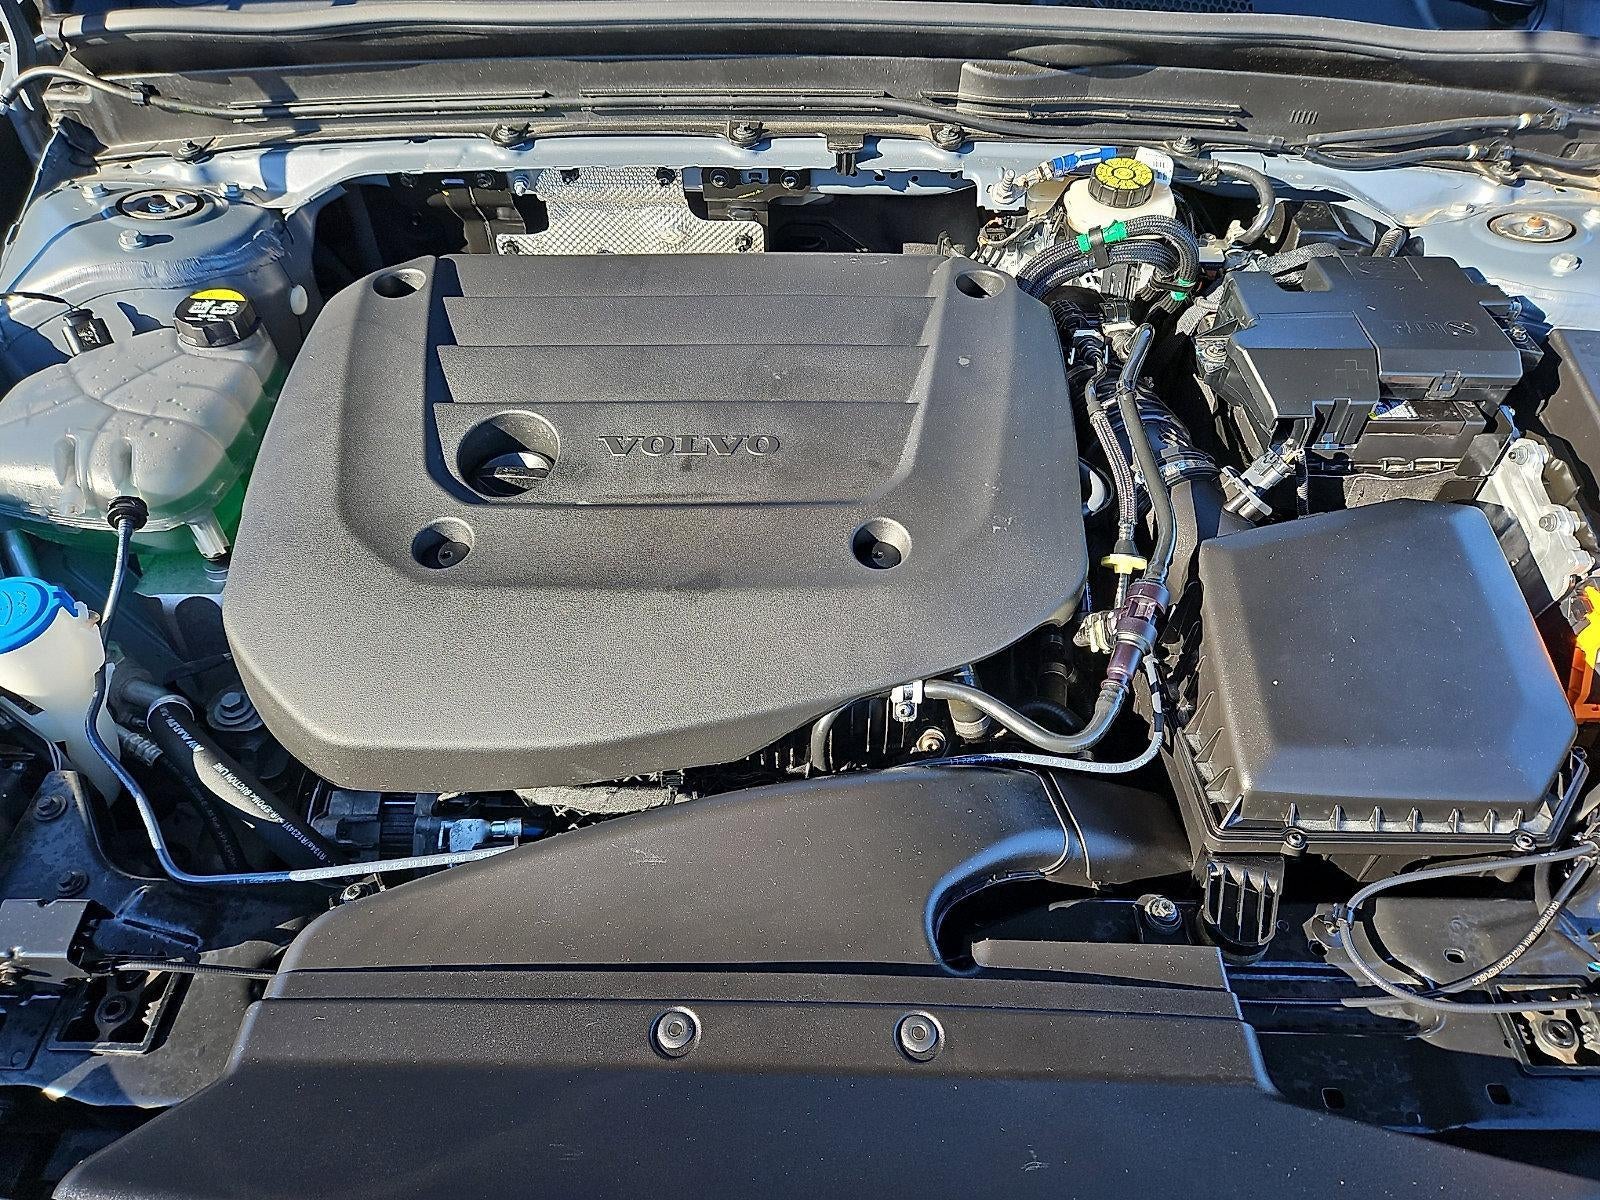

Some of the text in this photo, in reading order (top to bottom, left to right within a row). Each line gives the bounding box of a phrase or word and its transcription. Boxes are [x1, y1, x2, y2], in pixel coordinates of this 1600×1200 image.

[598, 435, 780, 456] VOLVO
[212, 762, 229, 776] LINE
[225, 773, 252, 797] SUCTION
[1496, 954, 1514, 970] CZECH
[1471, 965, 1499, 985] REPUBLIC
